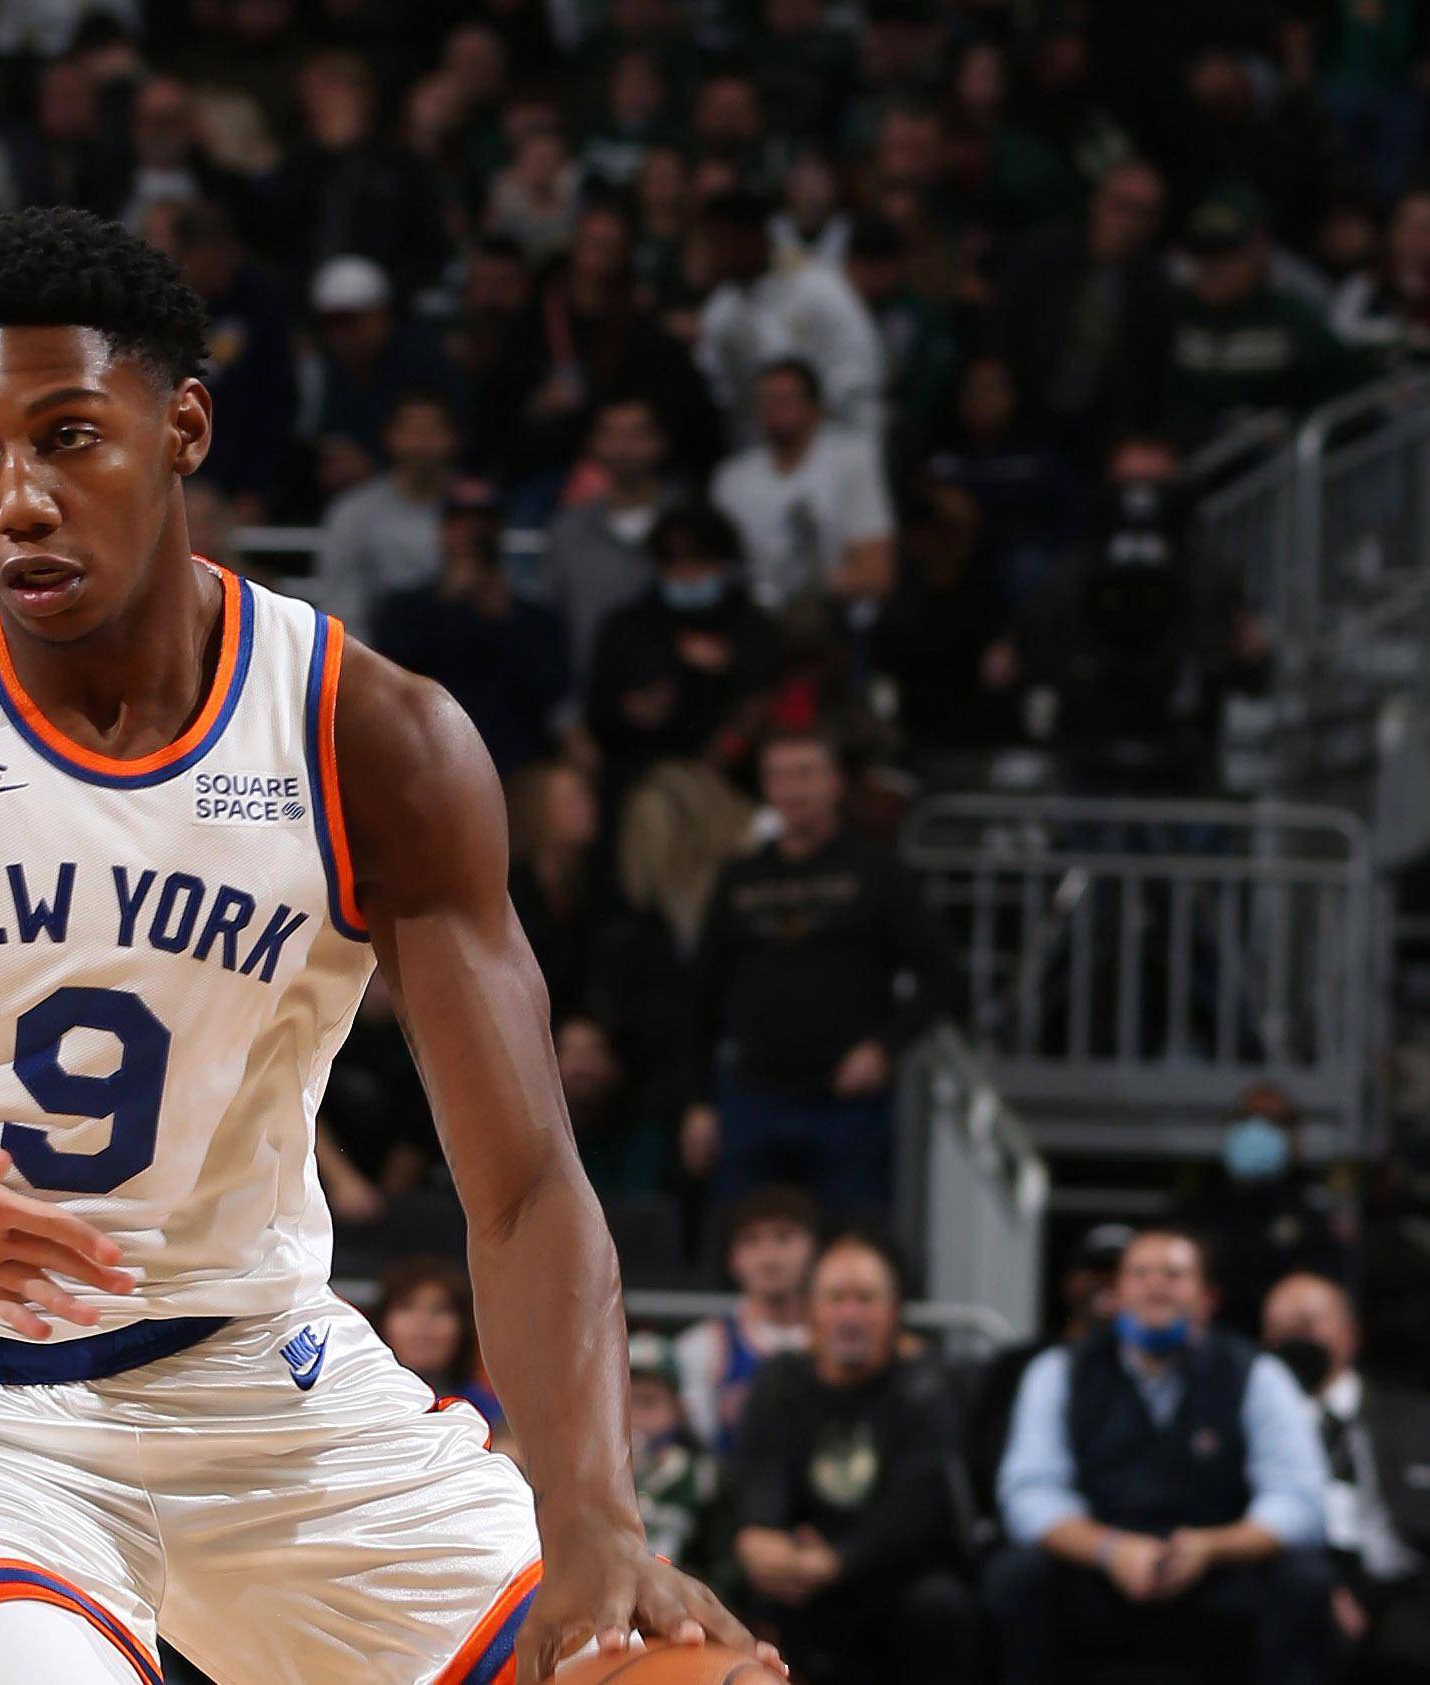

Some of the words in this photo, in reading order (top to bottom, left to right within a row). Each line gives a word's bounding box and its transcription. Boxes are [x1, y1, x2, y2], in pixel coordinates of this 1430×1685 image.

[195, 773, 299, 797] SQUARE
[195, 798, 279, 821] SPACE
[111, 865, 310, 984] YORK
[0, 986, 172, 1194] 9
[279, 1324, 321, 1371] NIKE
